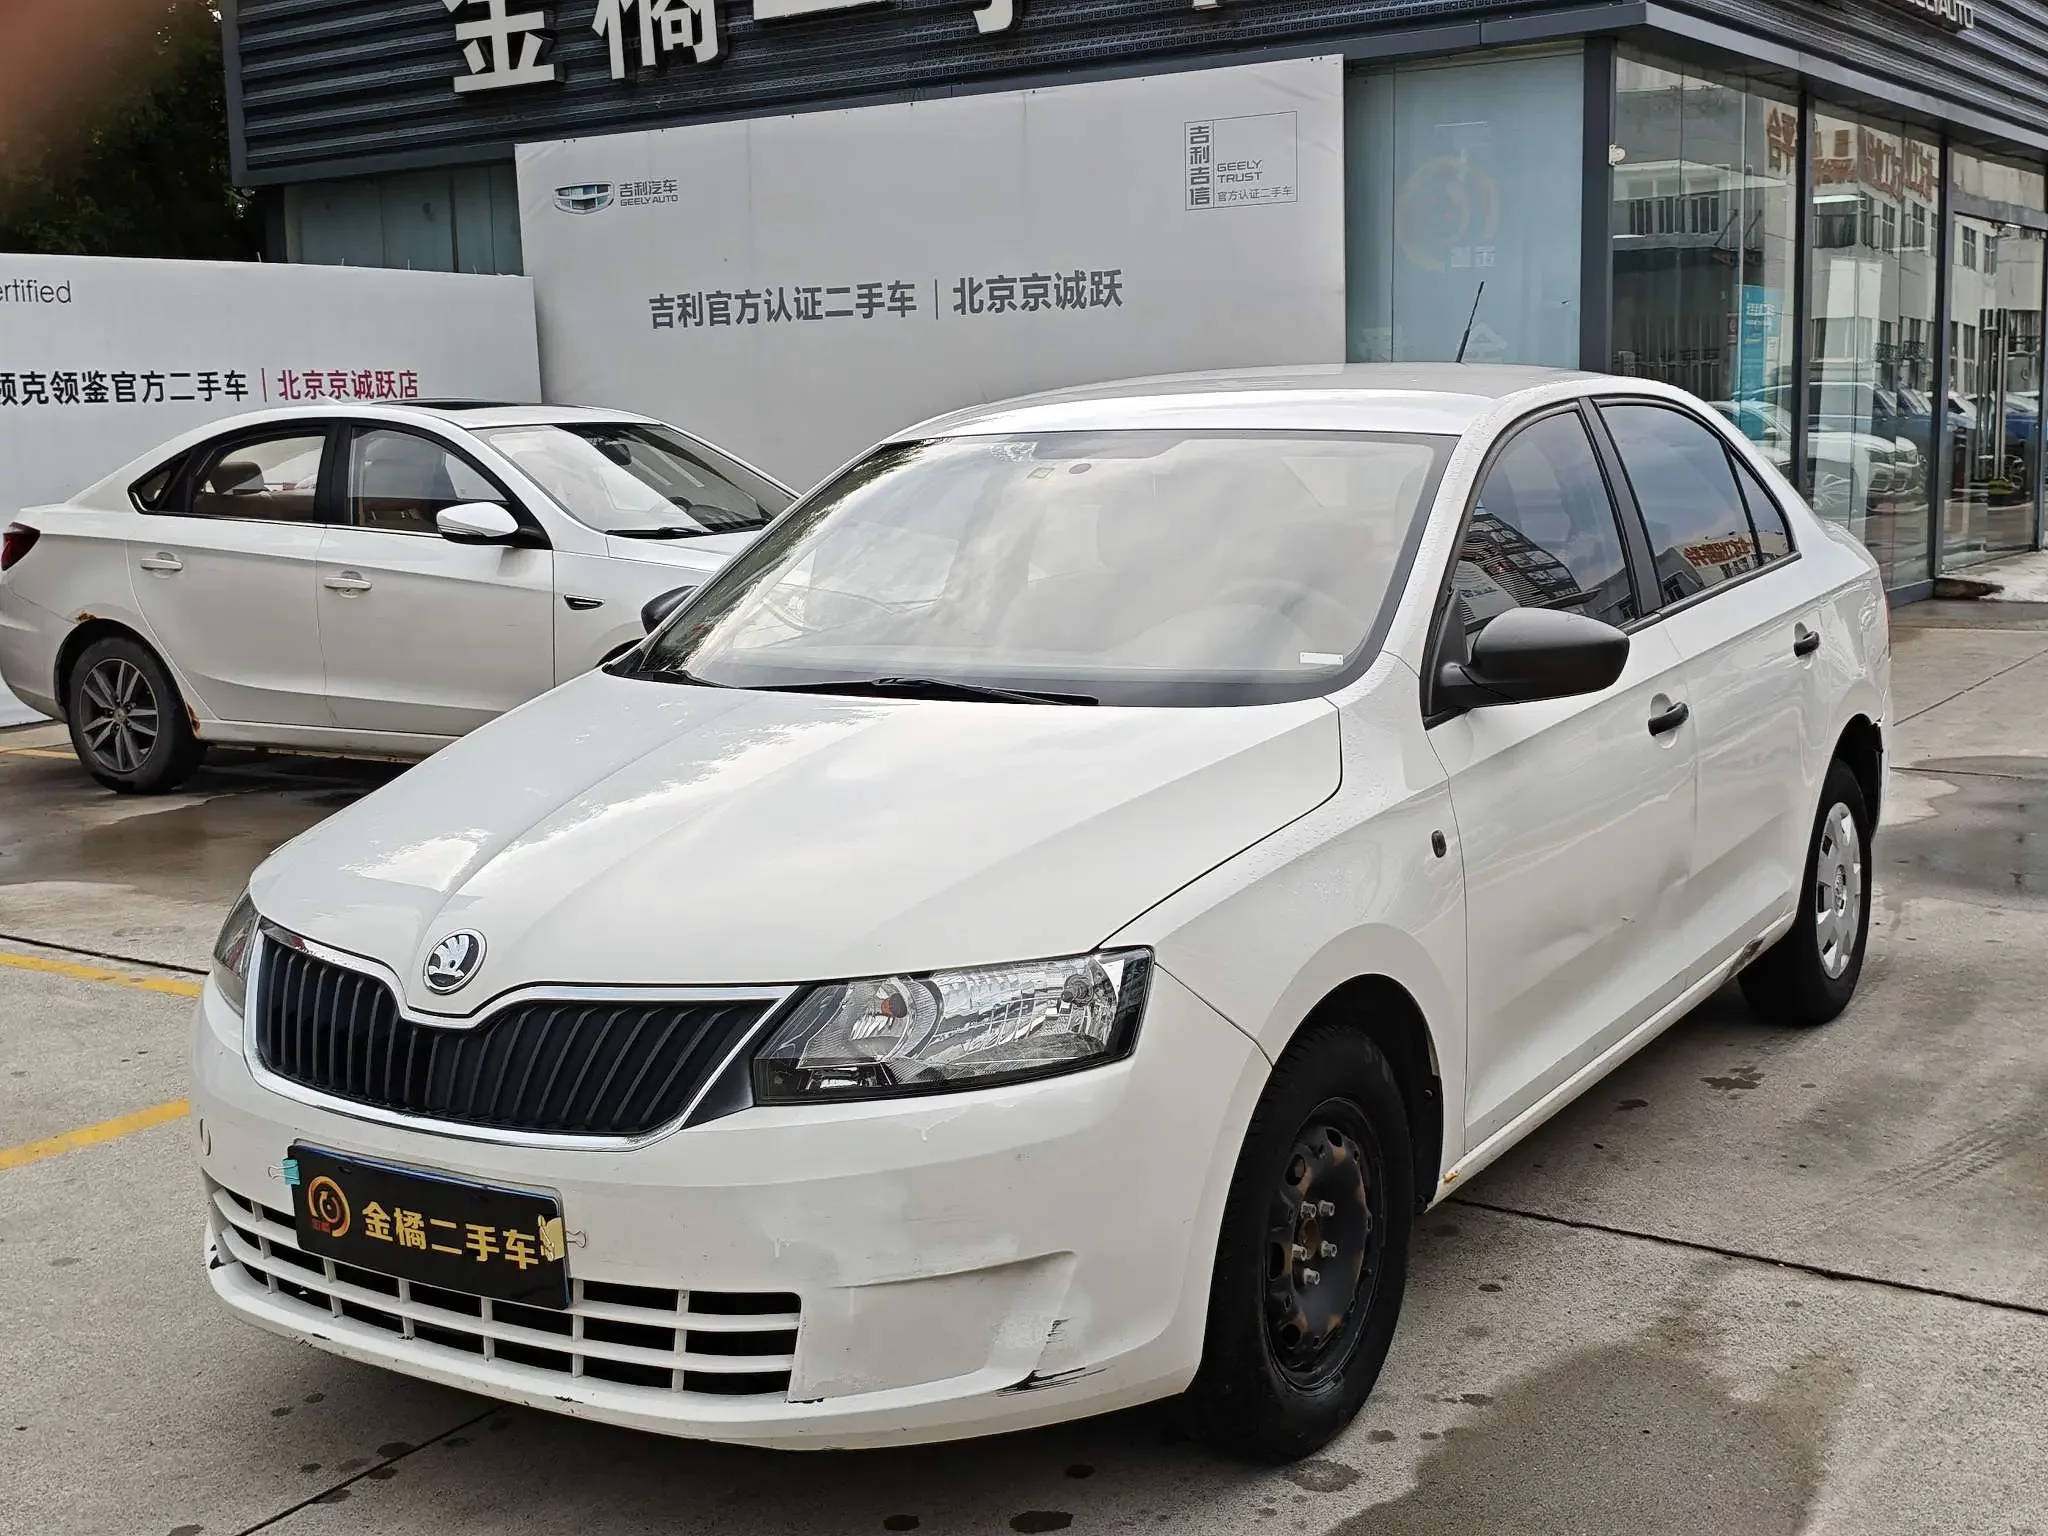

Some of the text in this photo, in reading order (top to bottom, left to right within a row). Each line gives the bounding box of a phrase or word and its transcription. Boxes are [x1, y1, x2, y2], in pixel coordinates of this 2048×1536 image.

[1189, 125, 1210, 205] 吉利吉信
[1217, 160, 1263, 172] GEELY
[1217, 171, 1263, 183] TRUST
[620, 179, 678, 198] 吉利汽车
[1217, 186, 1295, 202] 官方认证二手车
[620, 194, 678, 207] GEELY AUTO
[0, 279, 72, 304] rtified
[649, 269, 1123, 329] 吉利官方认证二手车 北京京诚跃
[277, 370, 418, 401] 北京京诚跃店
[362, 1201, 545, 1270] 金橘二手车
